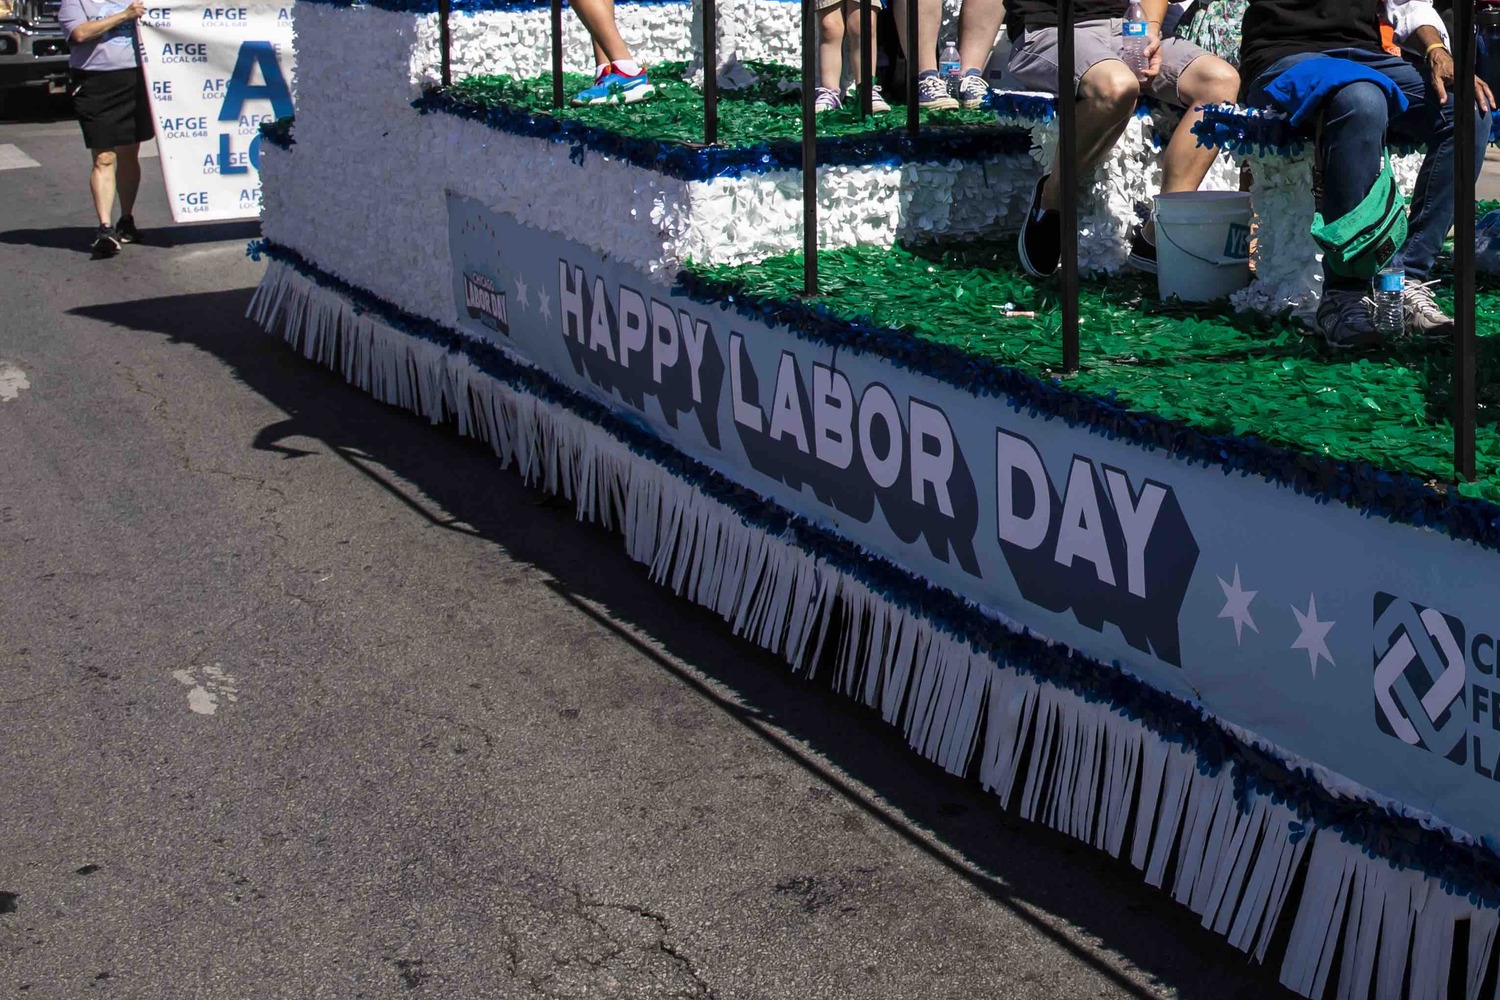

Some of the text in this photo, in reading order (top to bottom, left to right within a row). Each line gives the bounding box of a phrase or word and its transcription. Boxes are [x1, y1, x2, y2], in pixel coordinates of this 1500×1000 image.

[203, 8, 247, 20] AFGE
[162, 43, 207, 55] AFGE
[191, 55, 208, 63] 648
[163, 117, 207, 130] AFGE
[238, 114, 272, 127] AFG
[167, 131, 190, 139] OCAL
[463, 275, 492, 314] LABOR
[490, 292, 508, 325] DAY
[558, 258, 1174, 600] HAPPY LABOR DAY
